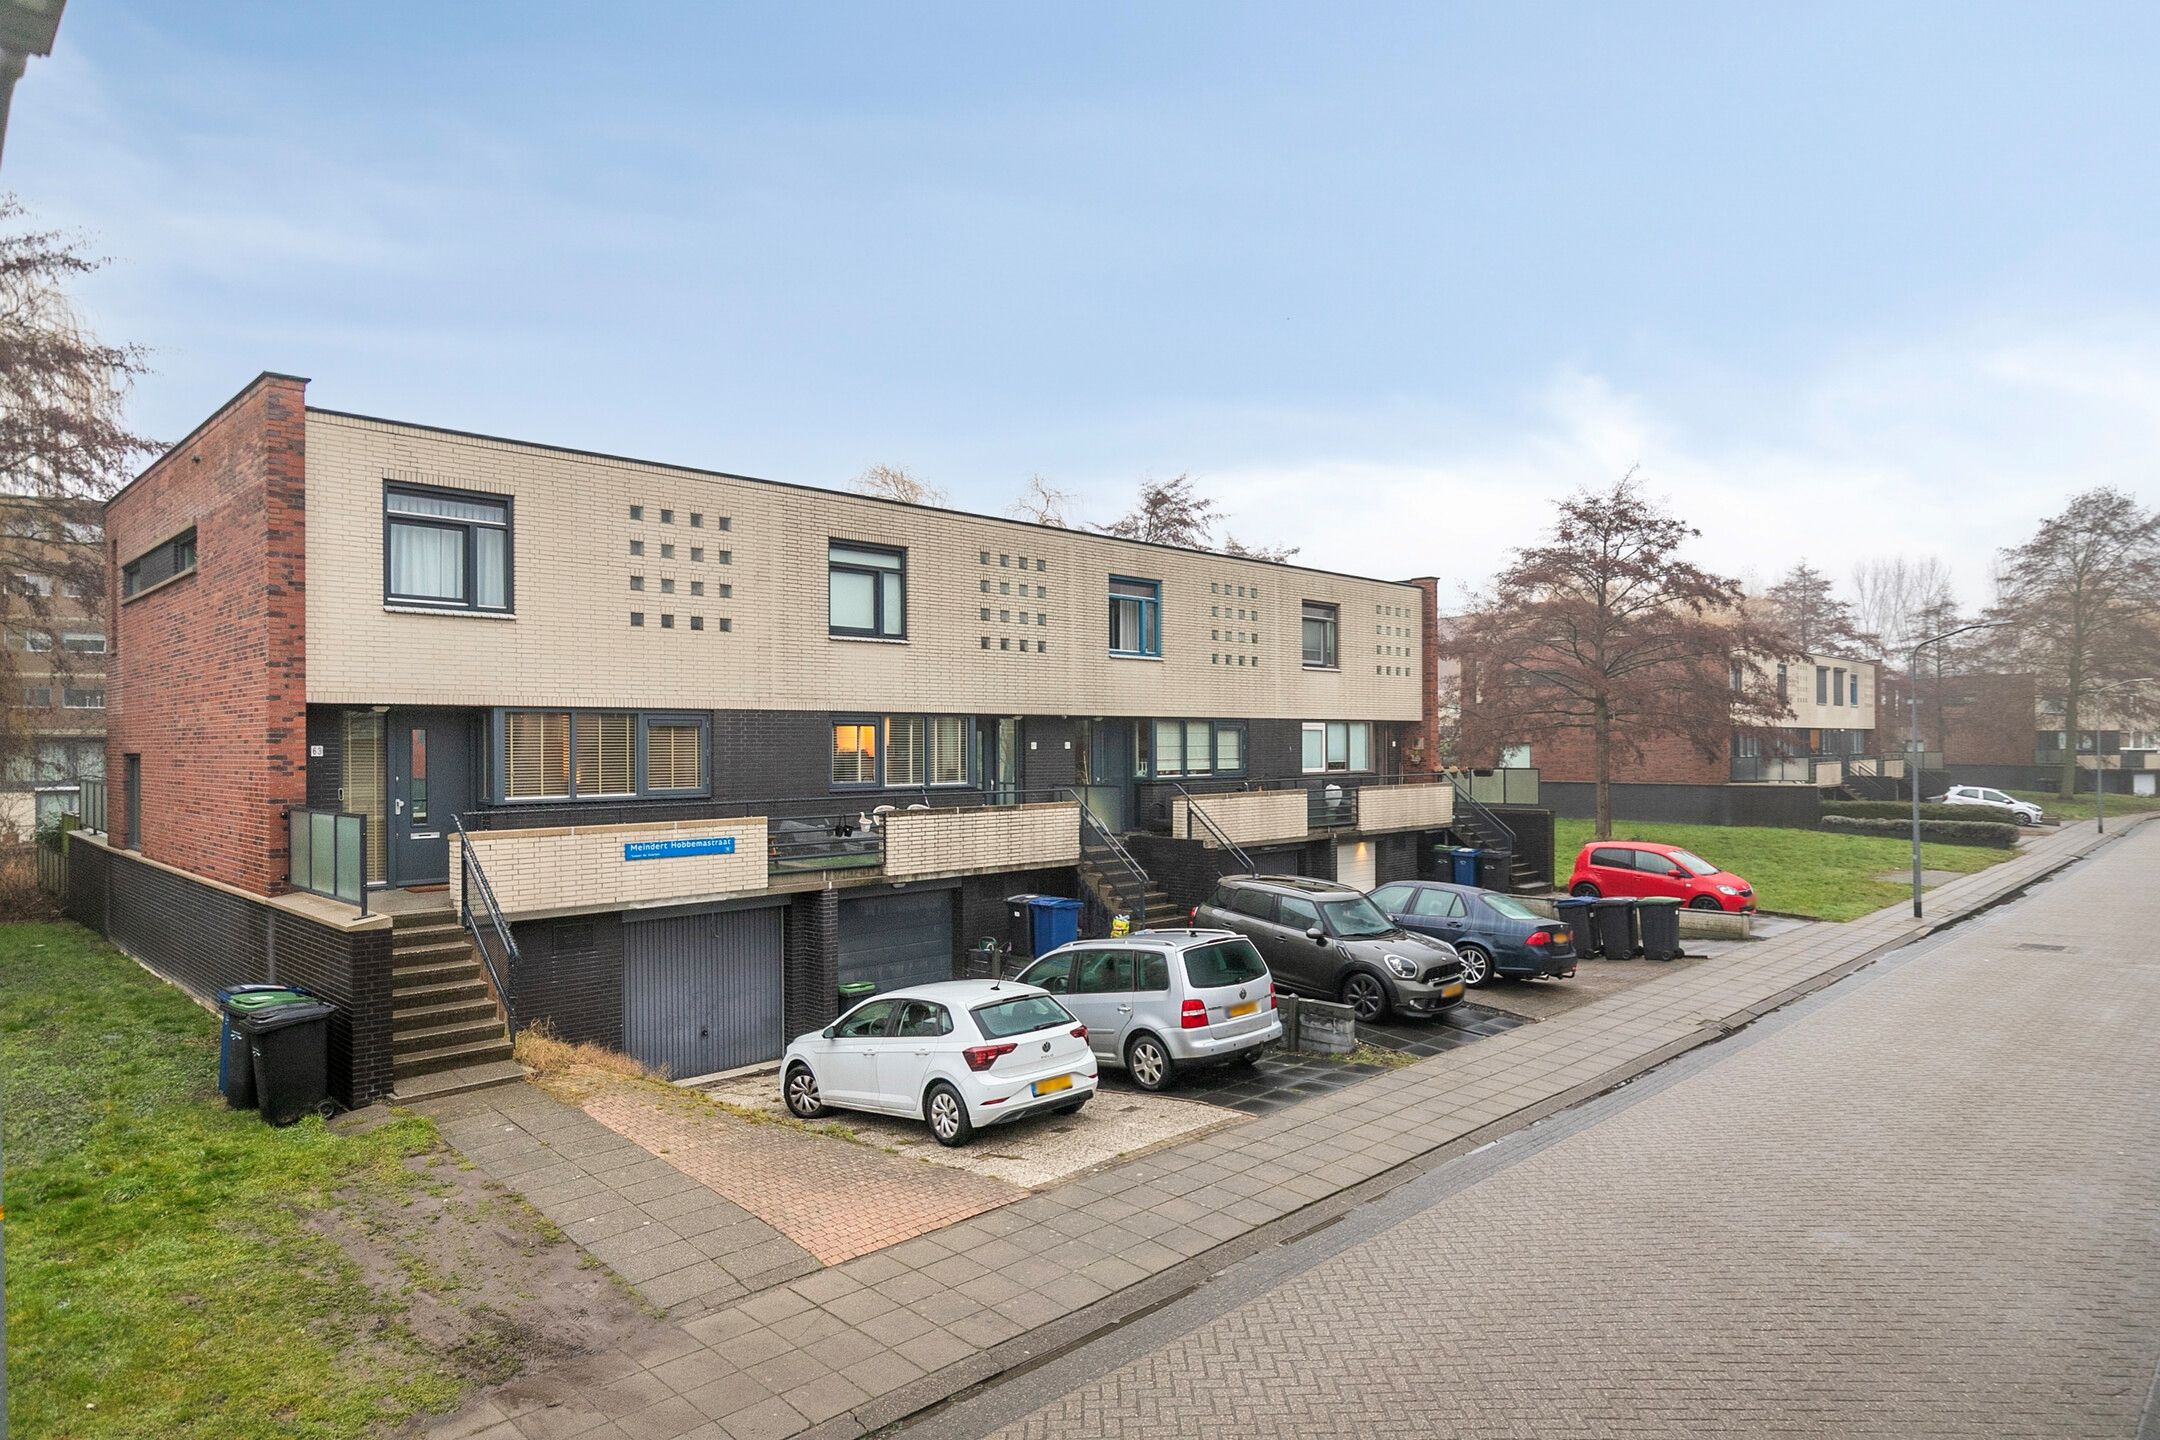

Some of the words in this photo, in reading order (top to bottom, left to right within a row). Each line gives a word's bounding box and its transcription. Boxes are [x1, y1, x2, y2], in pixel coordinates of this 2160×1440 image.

[312, 746, 322, 755] 63
[630, 842, 668, 851] Meindert
[671, 839, 731, 849] Hobbemastraat
